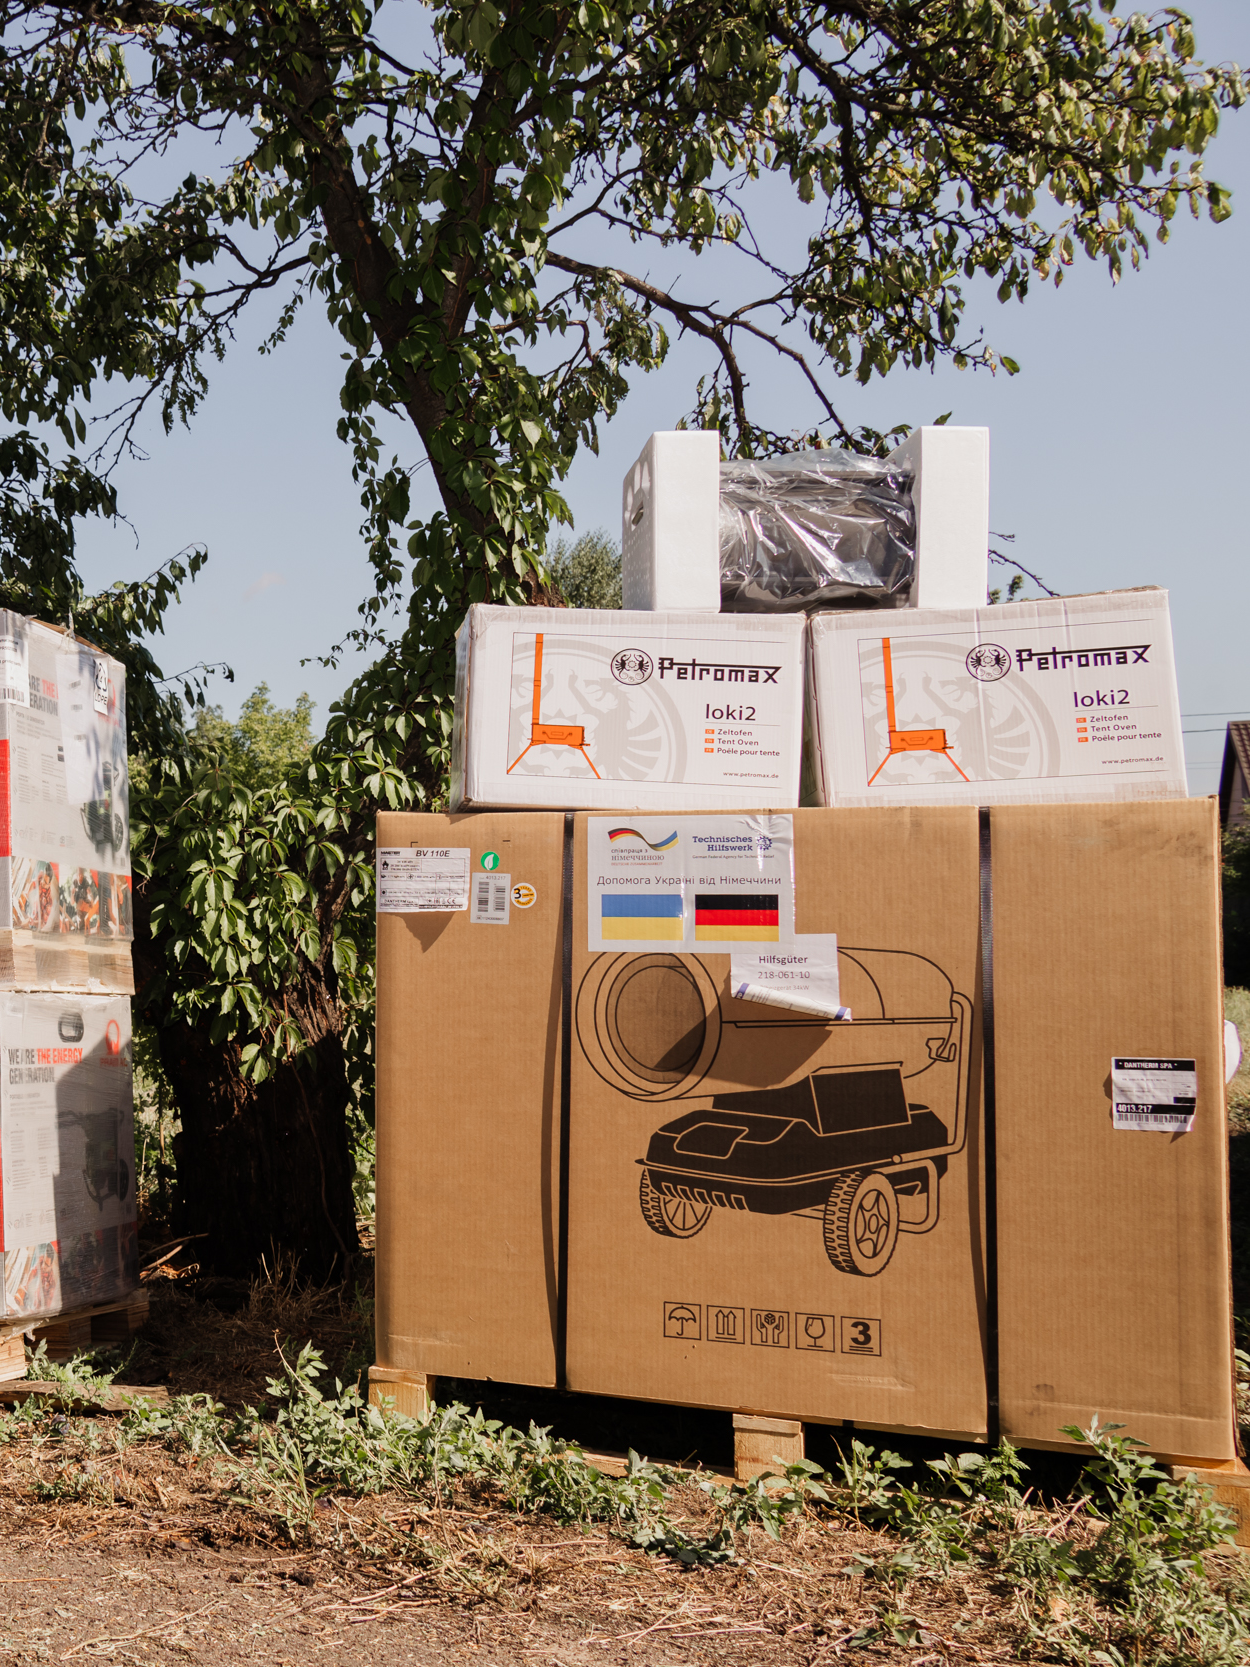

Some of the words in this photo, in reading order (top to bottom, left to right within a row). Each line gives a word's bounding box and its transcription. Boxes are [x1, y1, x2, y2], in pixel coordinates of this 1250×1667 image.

[1015, 644, 1152, 671] Petromax
[658, 657, 782, 684] Petromax
[1073, 689, 1130, 708] loki2
[30, 692, 58, 717] ERATION
[705, 703, 756, 721] loki2
[1090, 714, 1128, 722] Zeltofen
[1117, 734, 1137, 742] pour
[1102, 756, 1164, 764] www.petromax.de
[597, 876, 650, 886] Допомога
[655, 876, 695, 886] Україні
[700, 876, 716, 886] від
[720, 876, 781, 885] Німеччини
[514, 888, 522, 900] 3
[758, 955, 808, 965] Hilfsgüter
[757, 971, 810, 979] 218-061-10
[36, 1048, 51, 1064] THE
[52, 1048, 83, 1064] ENERGY
[1117, 1104, 1152, 1112] 4013.217
